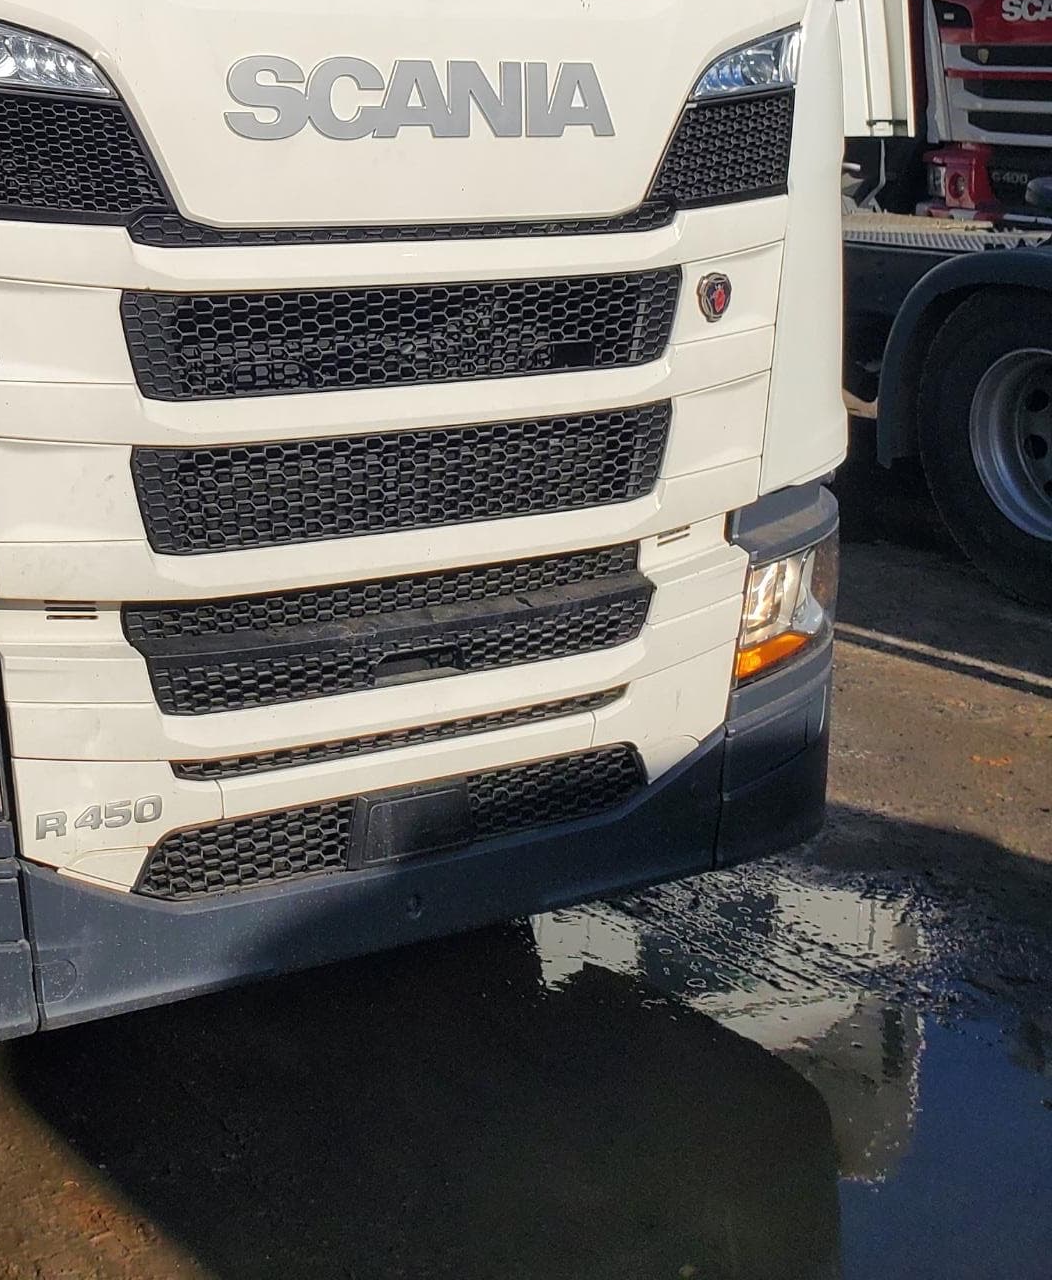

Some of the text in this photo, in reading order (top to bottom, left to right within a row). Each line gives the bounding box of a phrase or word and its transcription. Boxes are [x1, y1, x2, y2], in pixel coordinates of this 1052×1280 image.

[224, 55, 616, 141] SCANIA
[35, 794, 163, 841] R 450
